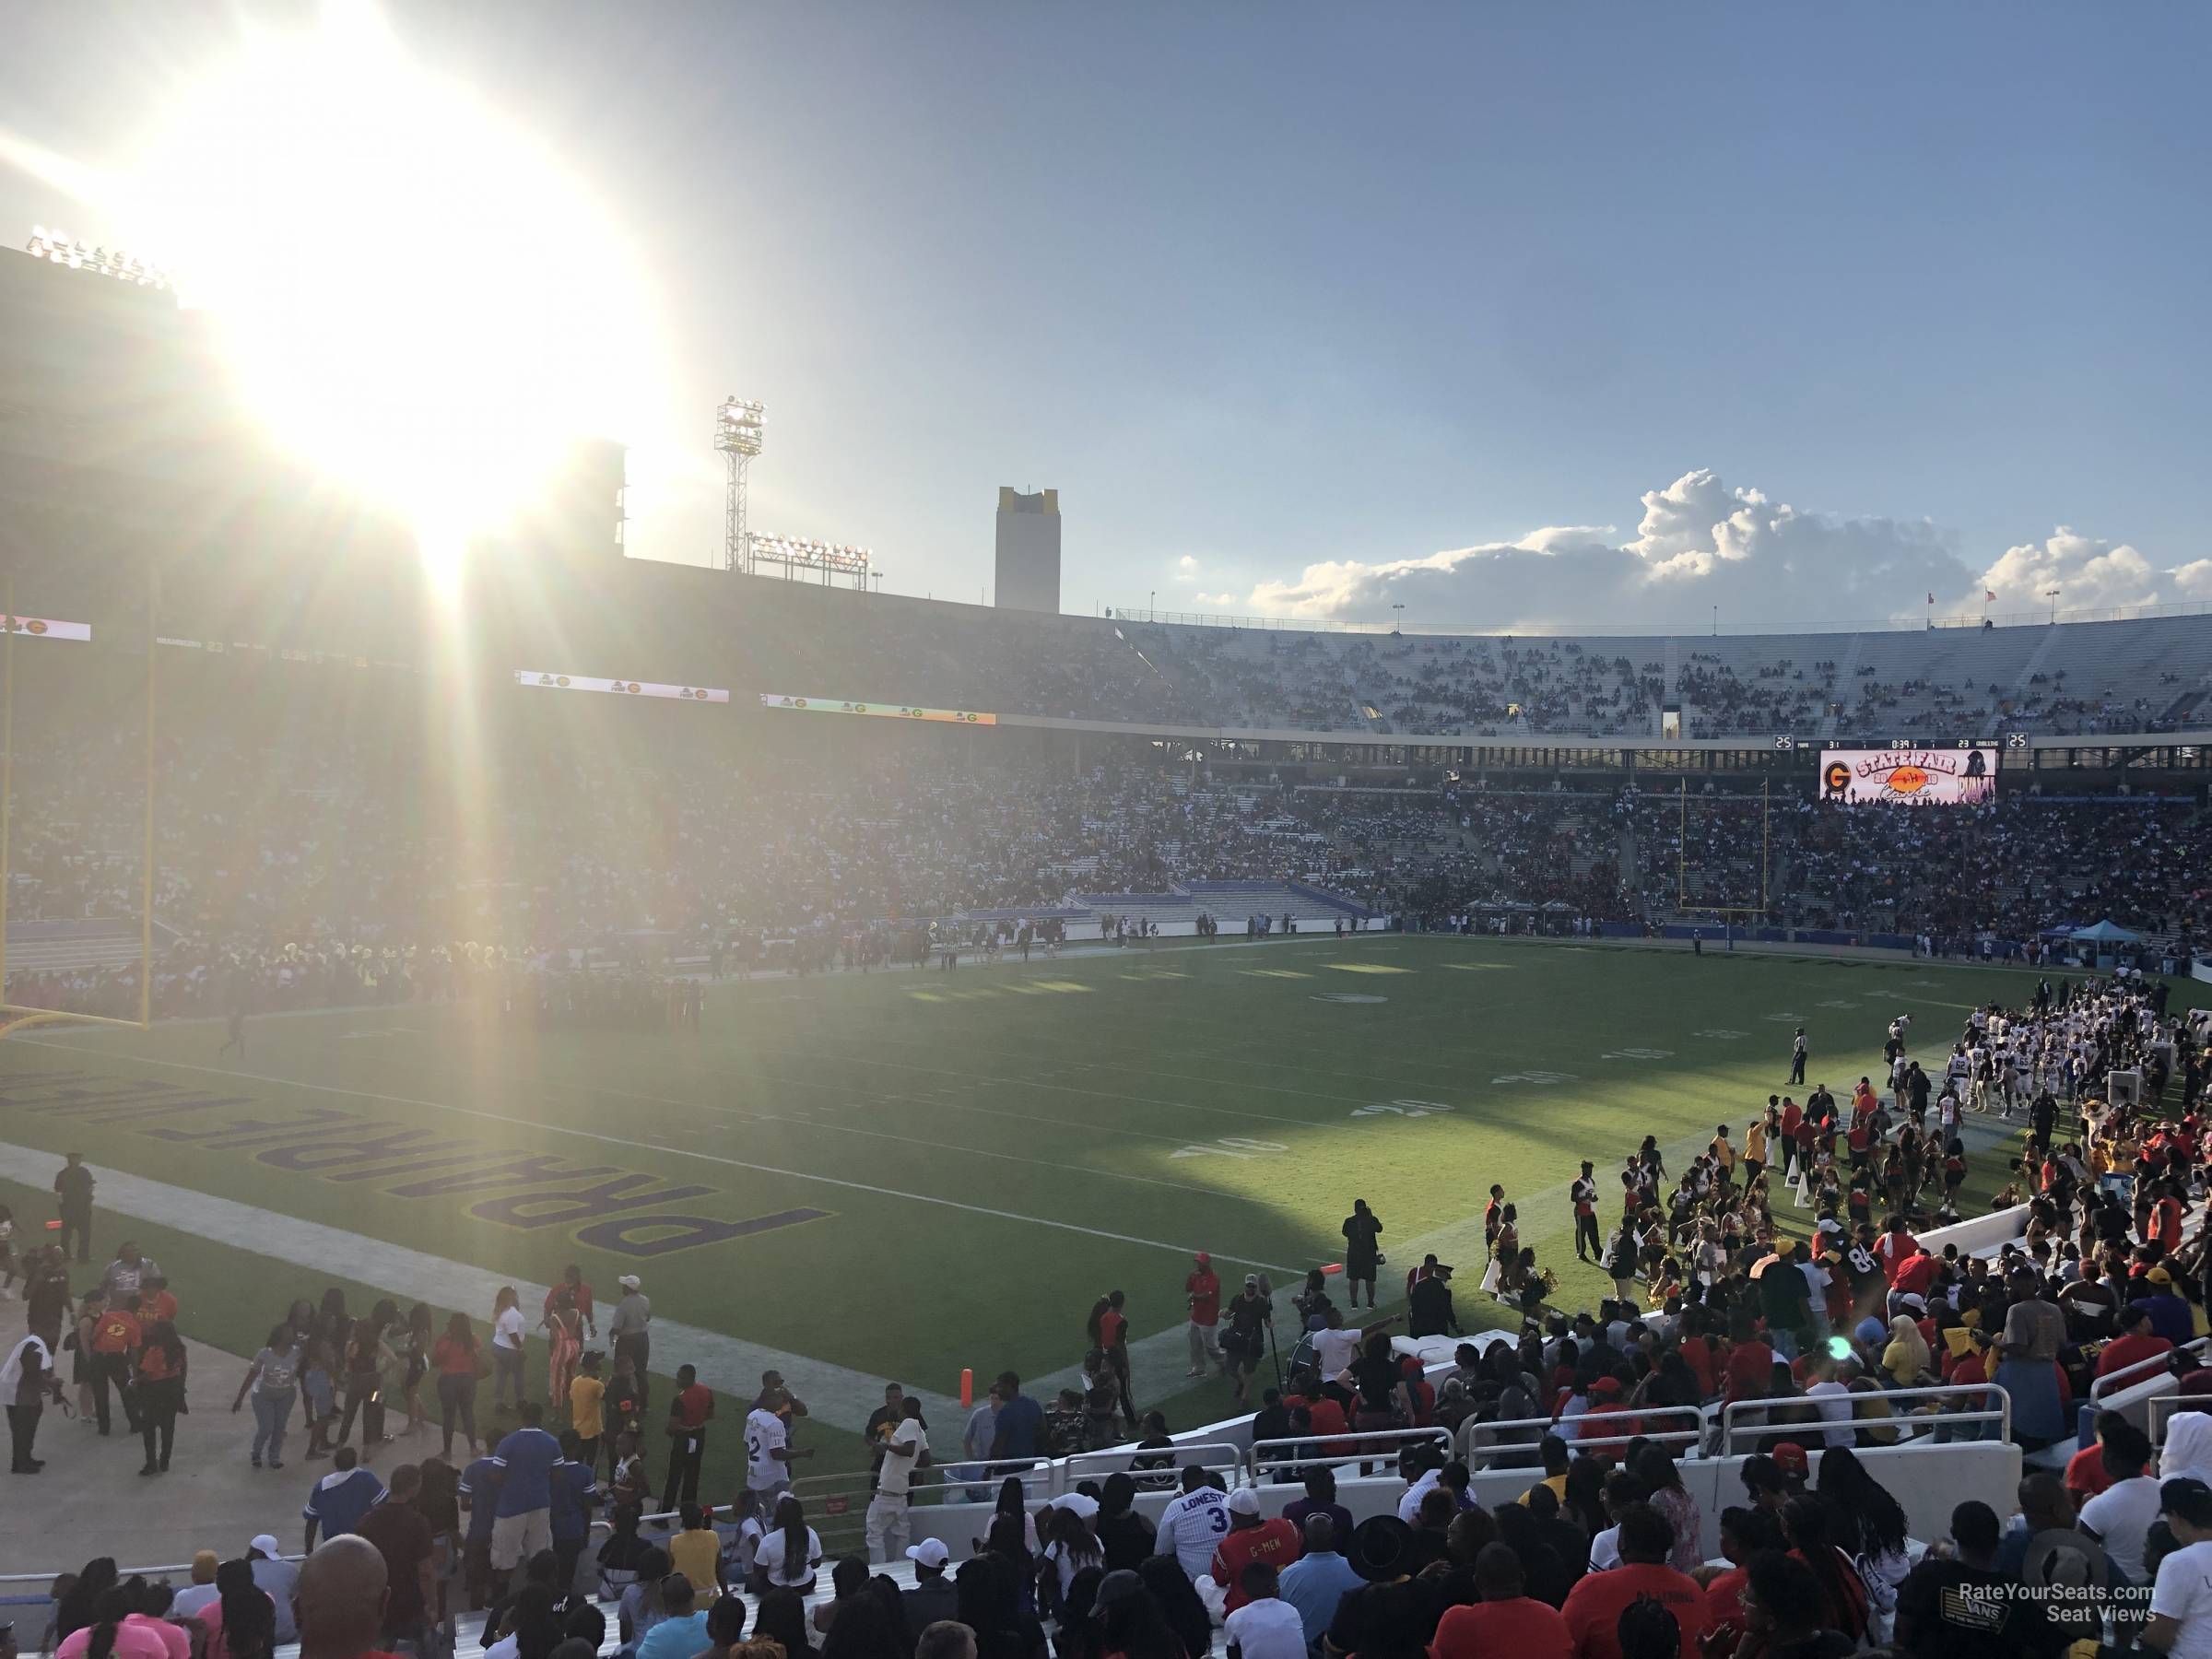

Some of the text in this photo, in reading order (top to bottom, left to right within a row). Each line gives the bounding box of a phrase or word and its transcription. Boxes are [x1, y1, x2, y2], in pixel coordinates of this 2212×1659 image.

[1776, 736, 1792, 748] 25
[1892, 739, 1910, 749] 0:39
[1958, 739, 1970, 748] 23
[2009, 735, 2026, 747] 25
[1856, 750, 1956, 778] STATE FAIR
[1824, 759, 1853, 794] G
[1874, 772, 1888, 784] 20
[138, 1107, 838, 1259] PRAIRIE
[1249, 1536, 1283, 1559] G-MEN
[1965, 1596, 2002, 1622] VANS
